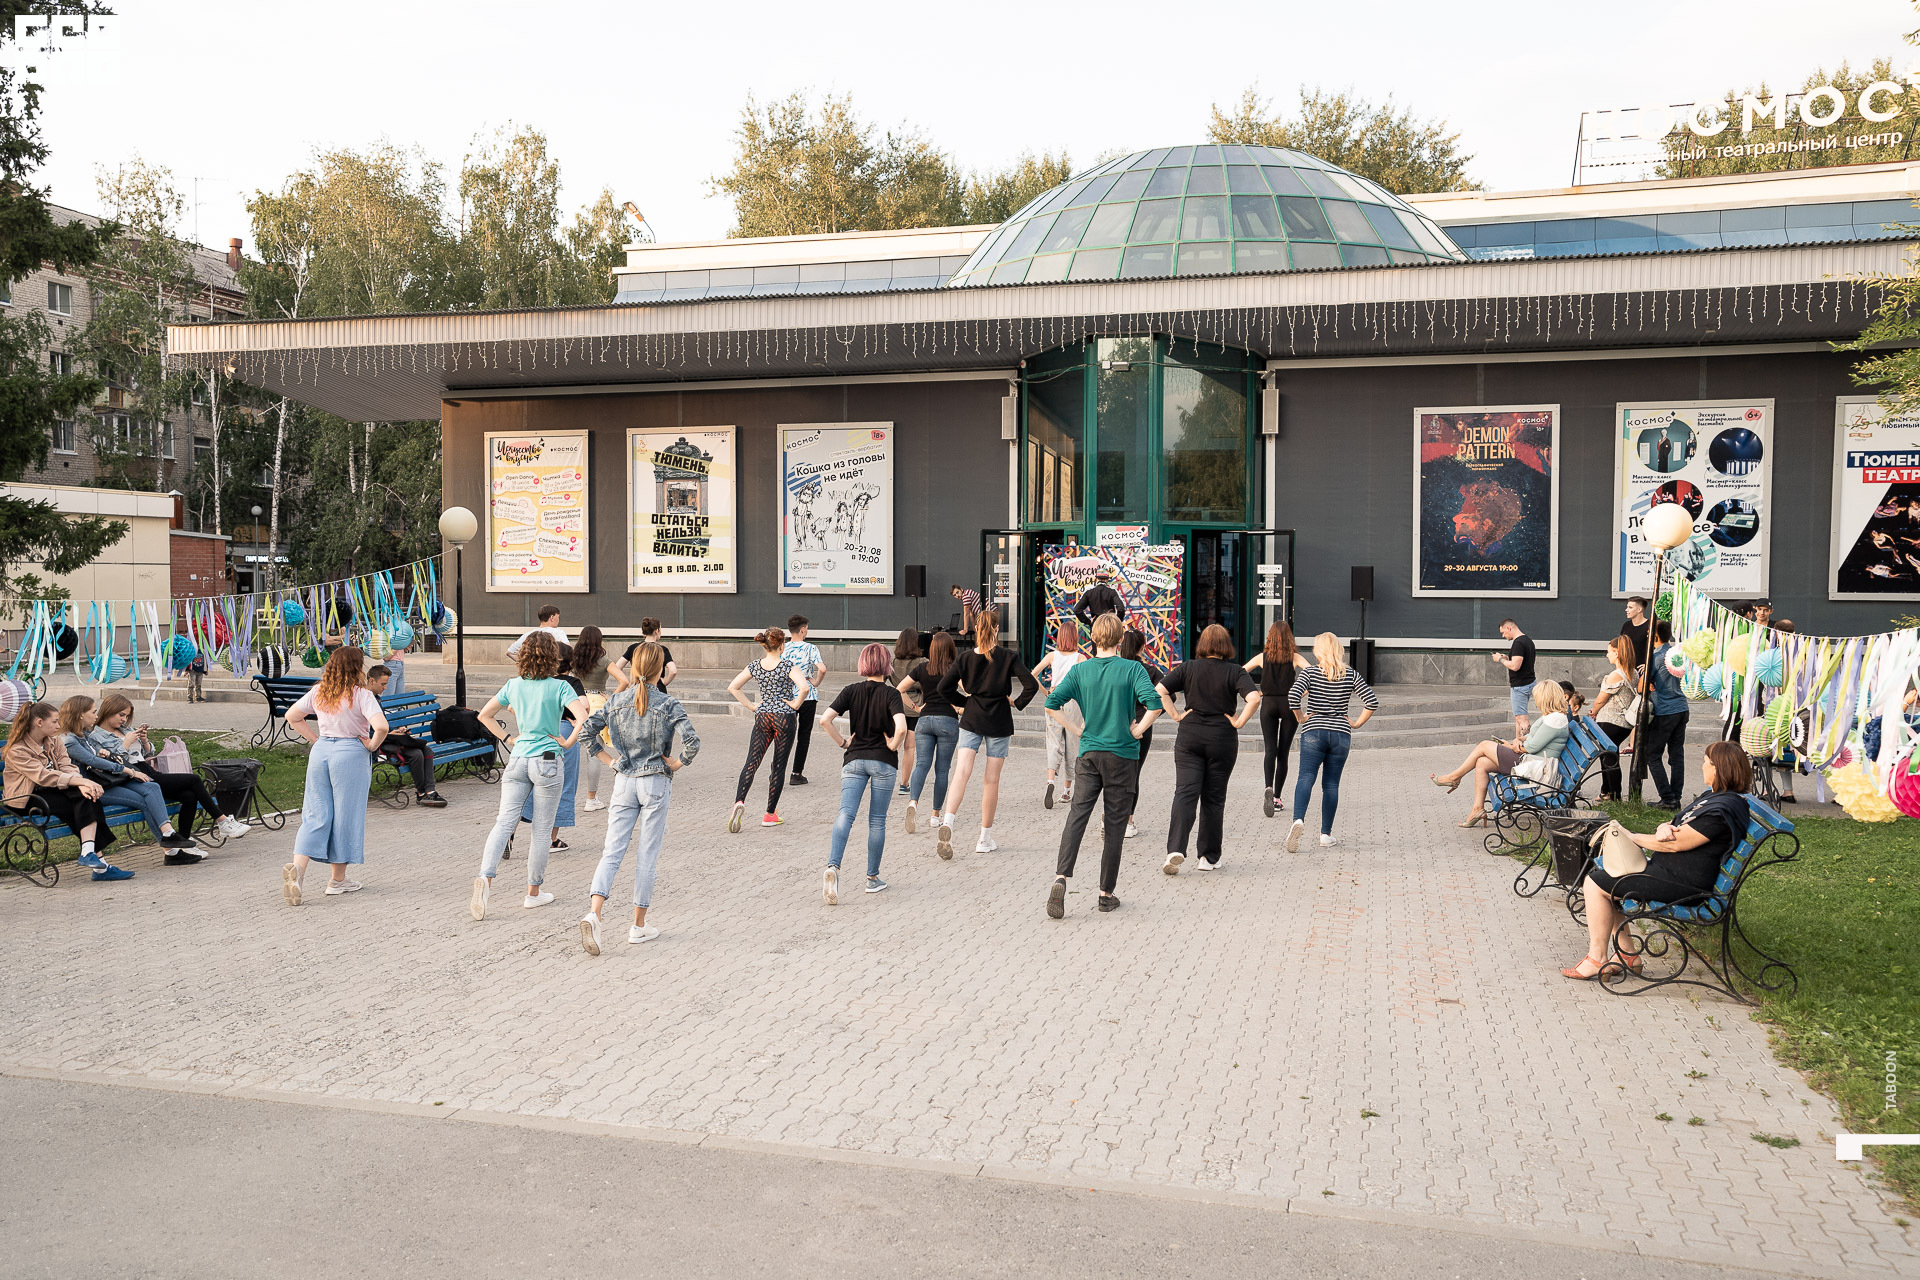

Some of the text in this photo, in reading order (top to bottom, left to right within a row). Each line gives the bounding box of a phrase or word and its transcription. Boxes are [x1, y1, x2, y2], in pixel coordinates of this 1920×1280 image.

[1714, 134, 1837, 158] театральный
[1845, 131, 1903, 149] центр
[1627, 416, 1672, 426] КОСМОС
[786, 434, 819, 449] КОСМОС
[1464, 426, 1509, 443] DEMON
[1458, 443, 1515, 460] PATTERN
[654, 451, 709, 474] ТЮМЕНЬ.
[796, 453, 885, 476] Кошка из головы
[824, 468, 864, 482] не идёт
[1865, 470, 1920, 482] ТЕАТР
[651, 514, 709, 527] ОСТАТЬСЯ
[657, 527, 702, 539] НЕЛЬЗЯ
[1102, 532, 1142, 540] КОСМОС
[653, 542, 707, 558] ВАЛИТЬ?
[844, 543, 881, 555] 20-21/08
[859, 554, 880, 564] 19:00
[643, 566, 663, 574] 14.08
[1124, 570, 1172, 585] OpenDance
